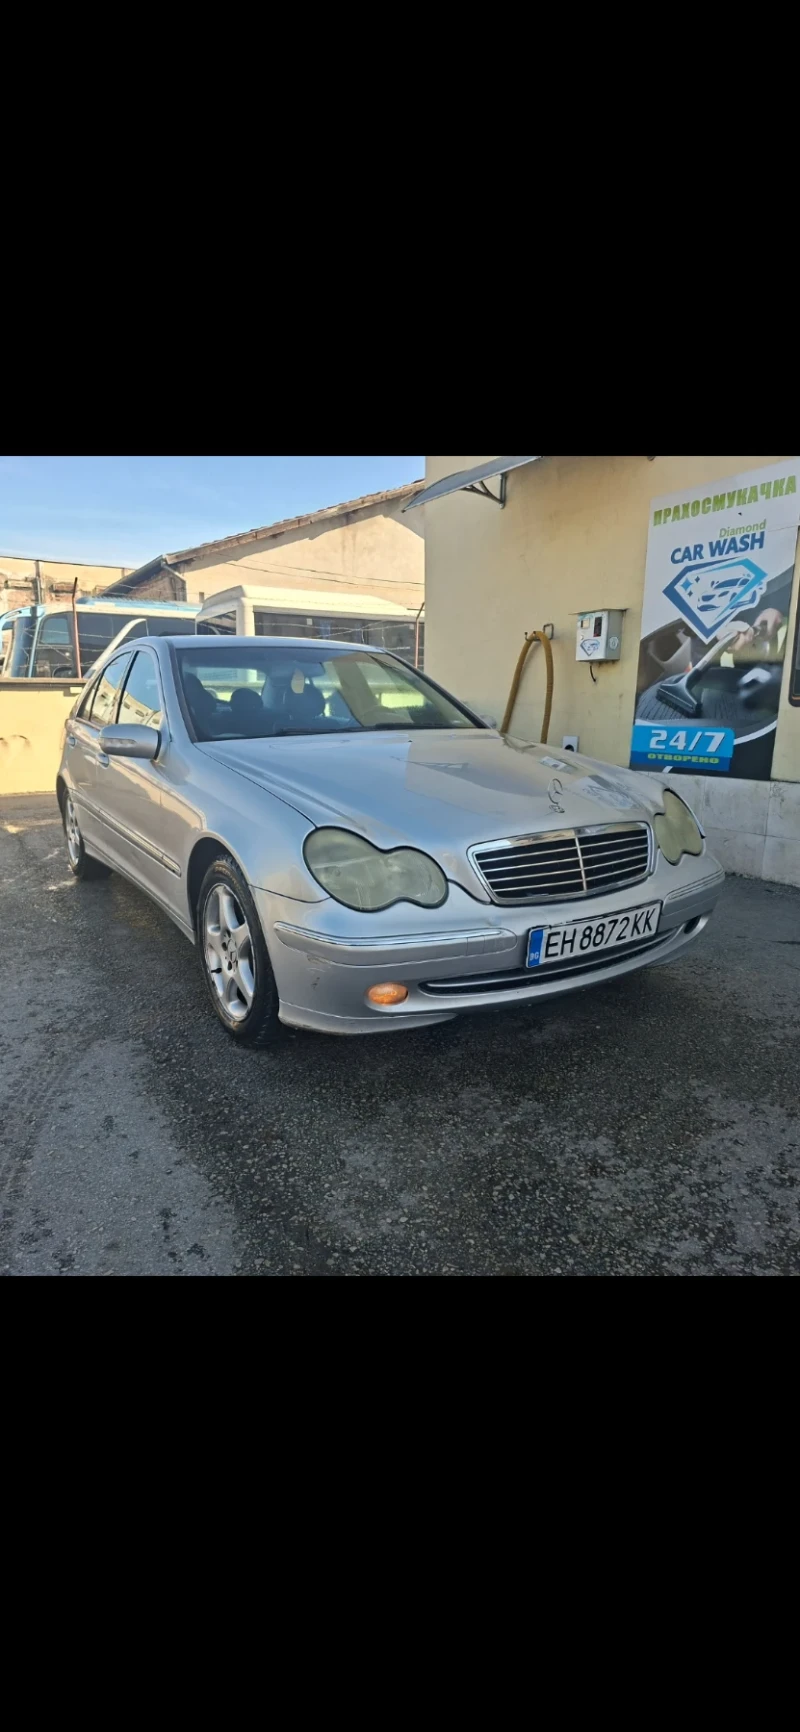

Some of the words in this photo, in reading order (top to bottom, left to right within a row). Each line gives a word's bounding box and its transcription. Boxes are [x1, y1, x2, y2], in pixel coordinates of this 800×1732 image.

[653, 475, 797, 526] ПРАХОСМУКАЧКА
[719, 519, 766, 538] Diamond
[670, 543, 704, 564] CAR
[708, 531, 765, 558] WASH
[649, 729, 726, 752] 24/7
[647, 753, 719, 764] ОТВОРЕНО
